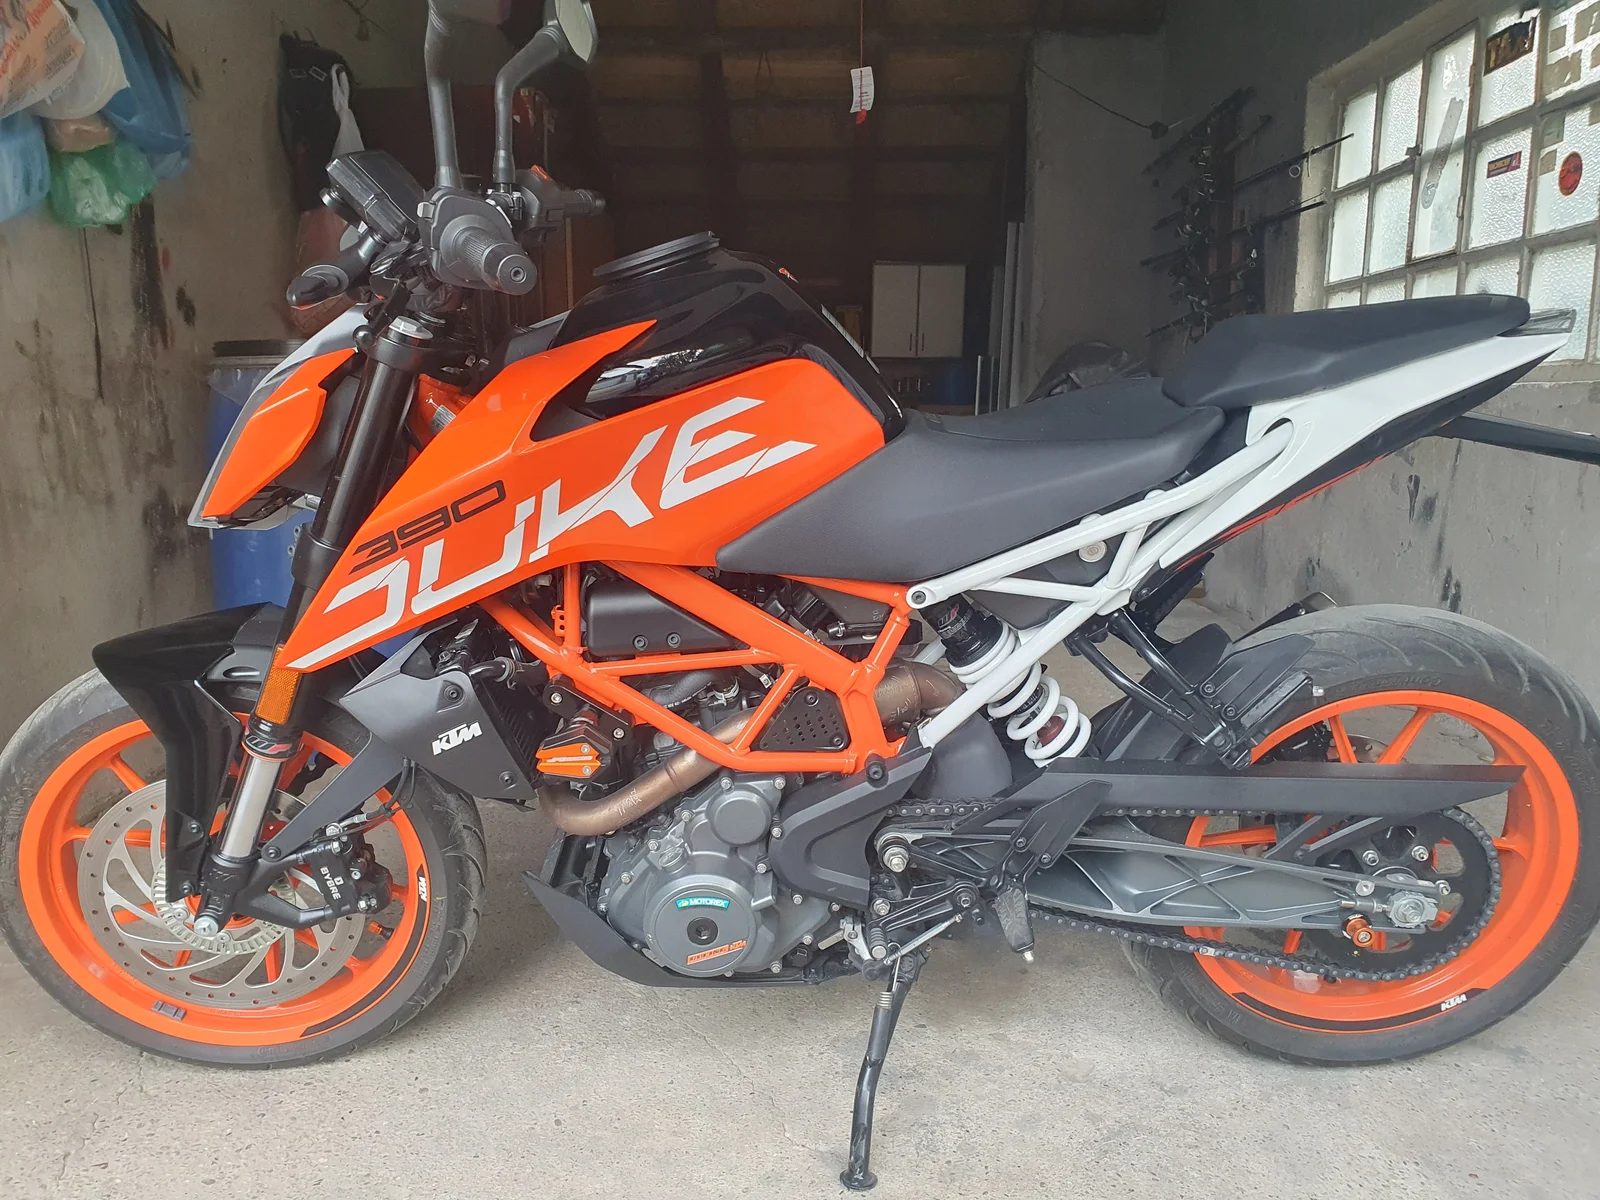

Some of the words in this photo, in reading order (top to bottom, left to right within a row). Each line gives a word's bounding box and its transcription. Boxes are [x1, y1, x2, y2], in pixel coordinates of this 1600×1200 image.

[285, 397, 817, 669] DUKE
[350, 480, 506, 573] 390
[432, 722, 482, 756] KTM
[320, 866, 341, 900] BYBRE
[418, 876, 428, 902] KTM
[689, 898, 726, 908] MOTOREX
[1440, 994, 1467, 1011] KTM
